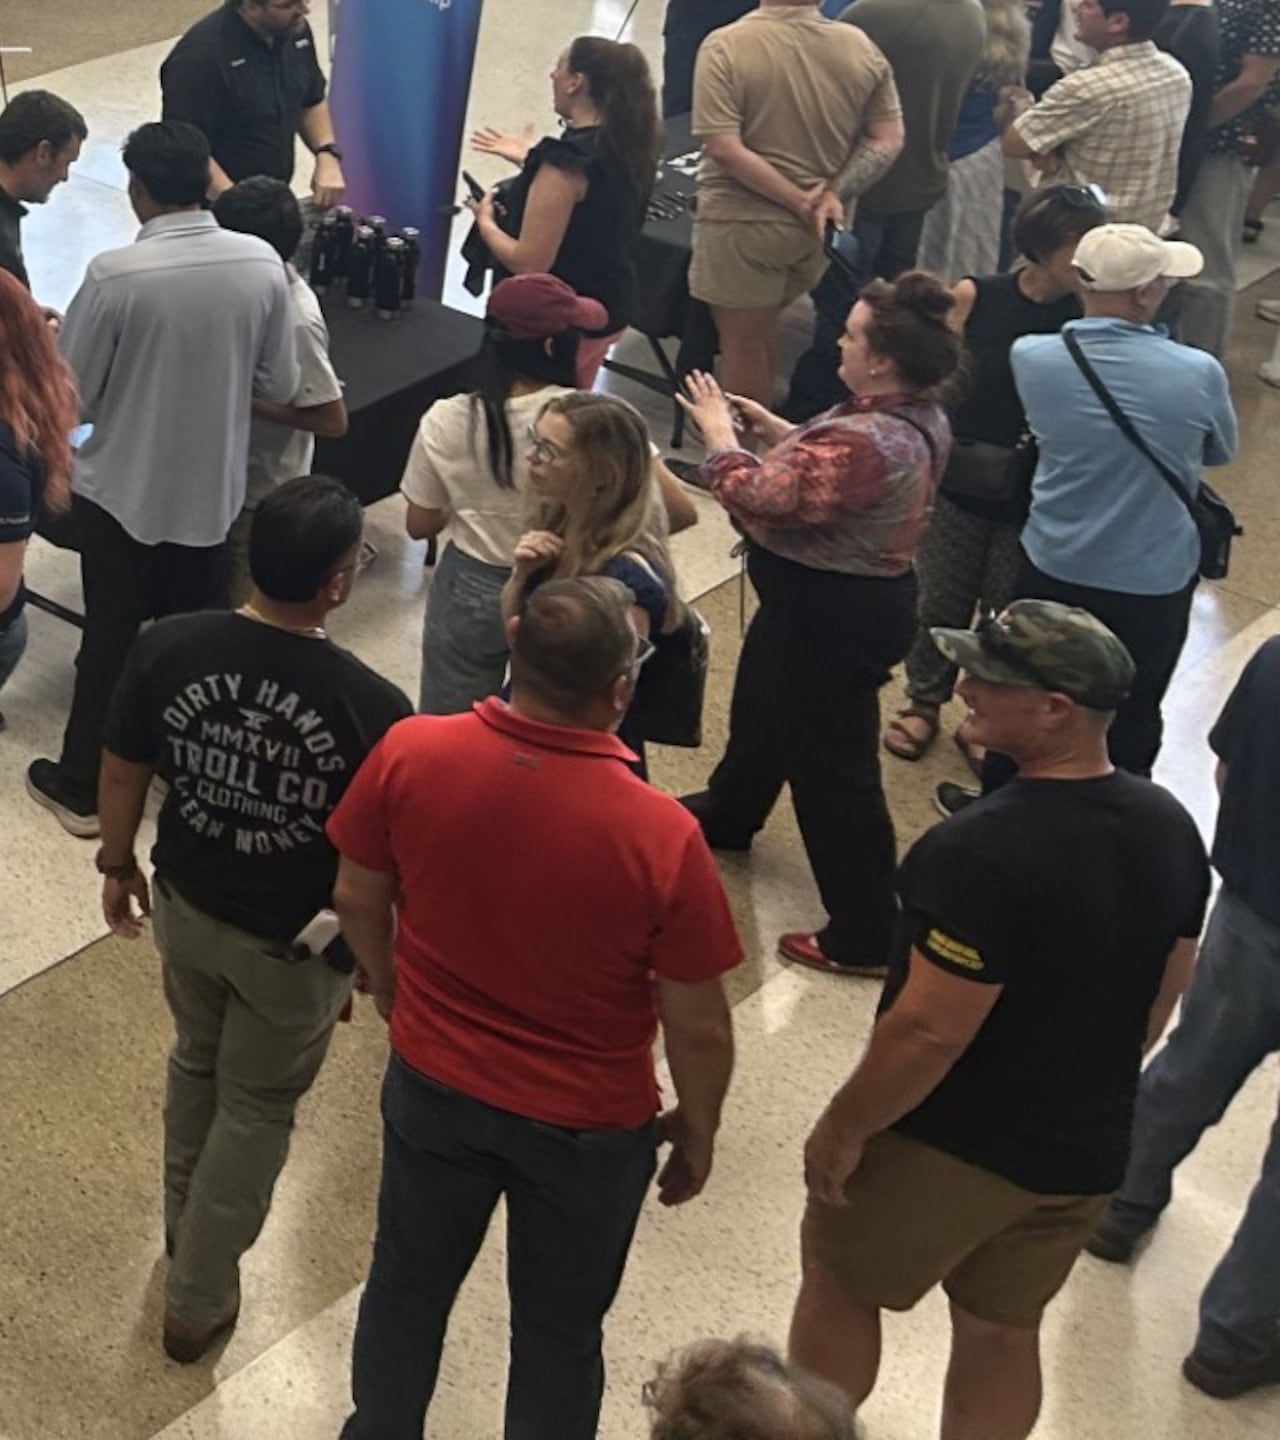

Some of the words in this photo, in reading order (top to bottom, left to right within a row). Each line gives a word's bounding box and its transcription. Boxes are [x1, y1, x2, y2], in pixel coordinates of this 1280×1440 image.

[163, 672, 243, 732] DIRTY
[255, 678, 346, 773] HANDS
[201, 719, 302, 769] MMXVII
[167, 735, 261, 797] TROLL
[196, 777, 288, 826] CLOTHING
